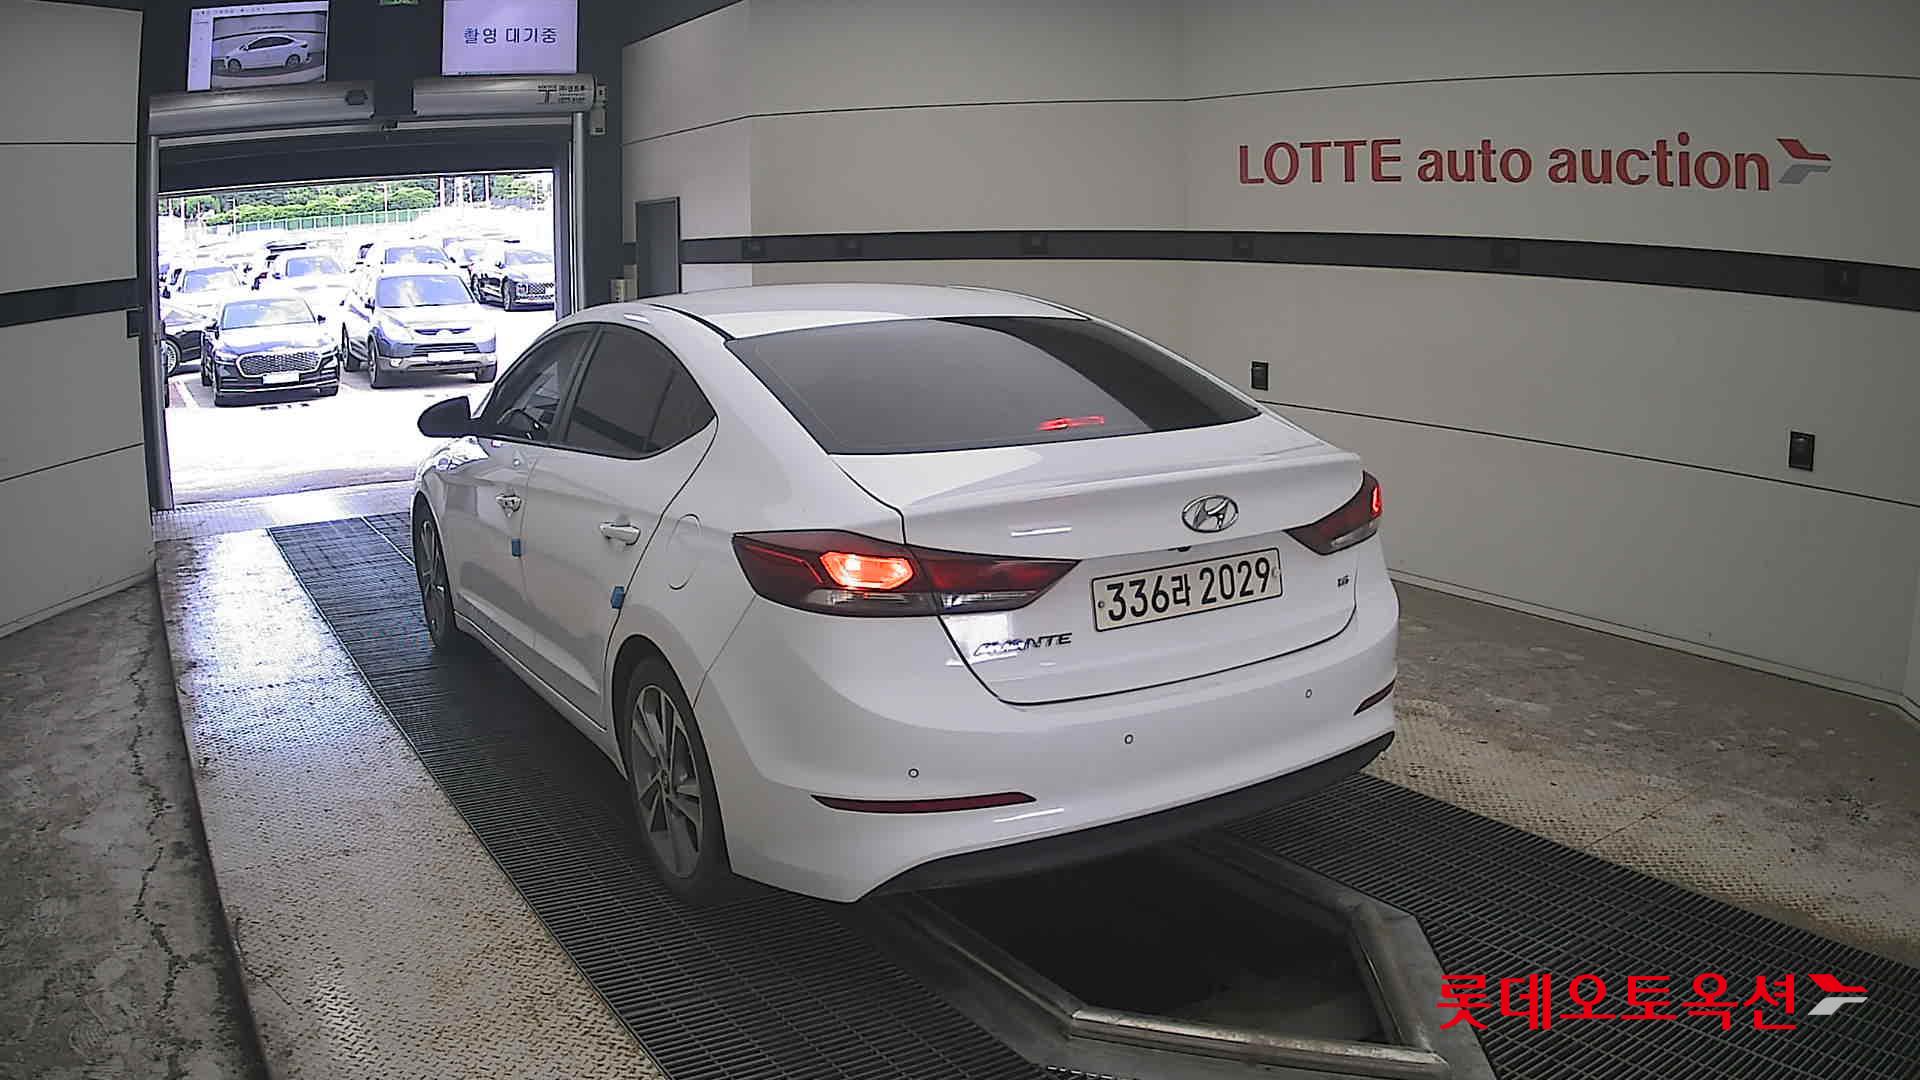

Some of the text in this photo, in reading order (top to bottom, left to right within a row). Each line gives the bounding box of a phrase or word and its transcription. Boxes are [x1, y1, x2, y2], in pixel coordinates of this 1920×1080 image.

[505, 27, 558, 44] 대기중
[1239, 131, 1771, 192] LOTTE auto auction
[1106, 556, 1271, 622] 336라 2029
